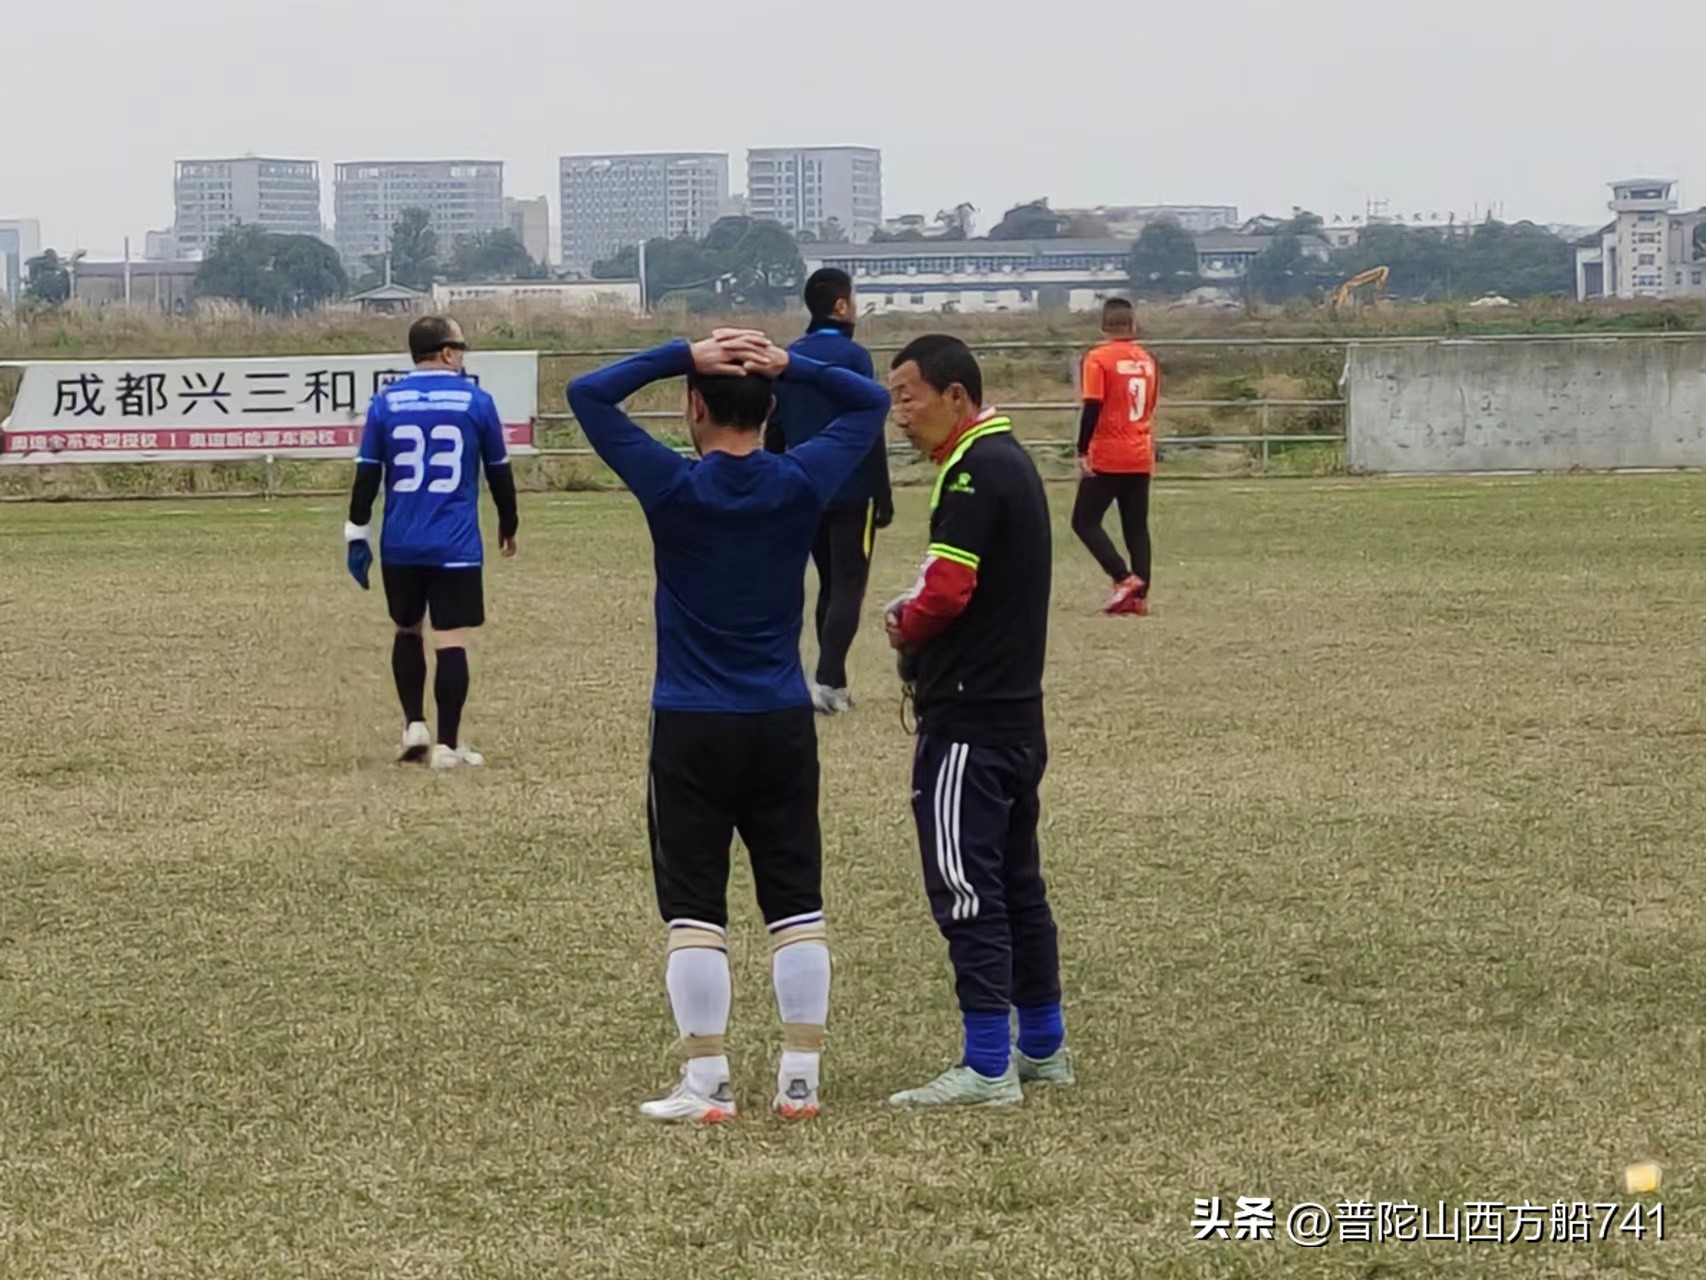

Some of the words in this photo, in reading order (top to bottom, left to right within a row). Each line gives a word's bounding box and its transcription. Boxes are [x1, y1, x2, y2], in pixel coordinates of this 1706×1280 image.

[53, 370, 480, 417] 成都兴三和
[391, 424, 464, 493] 33
